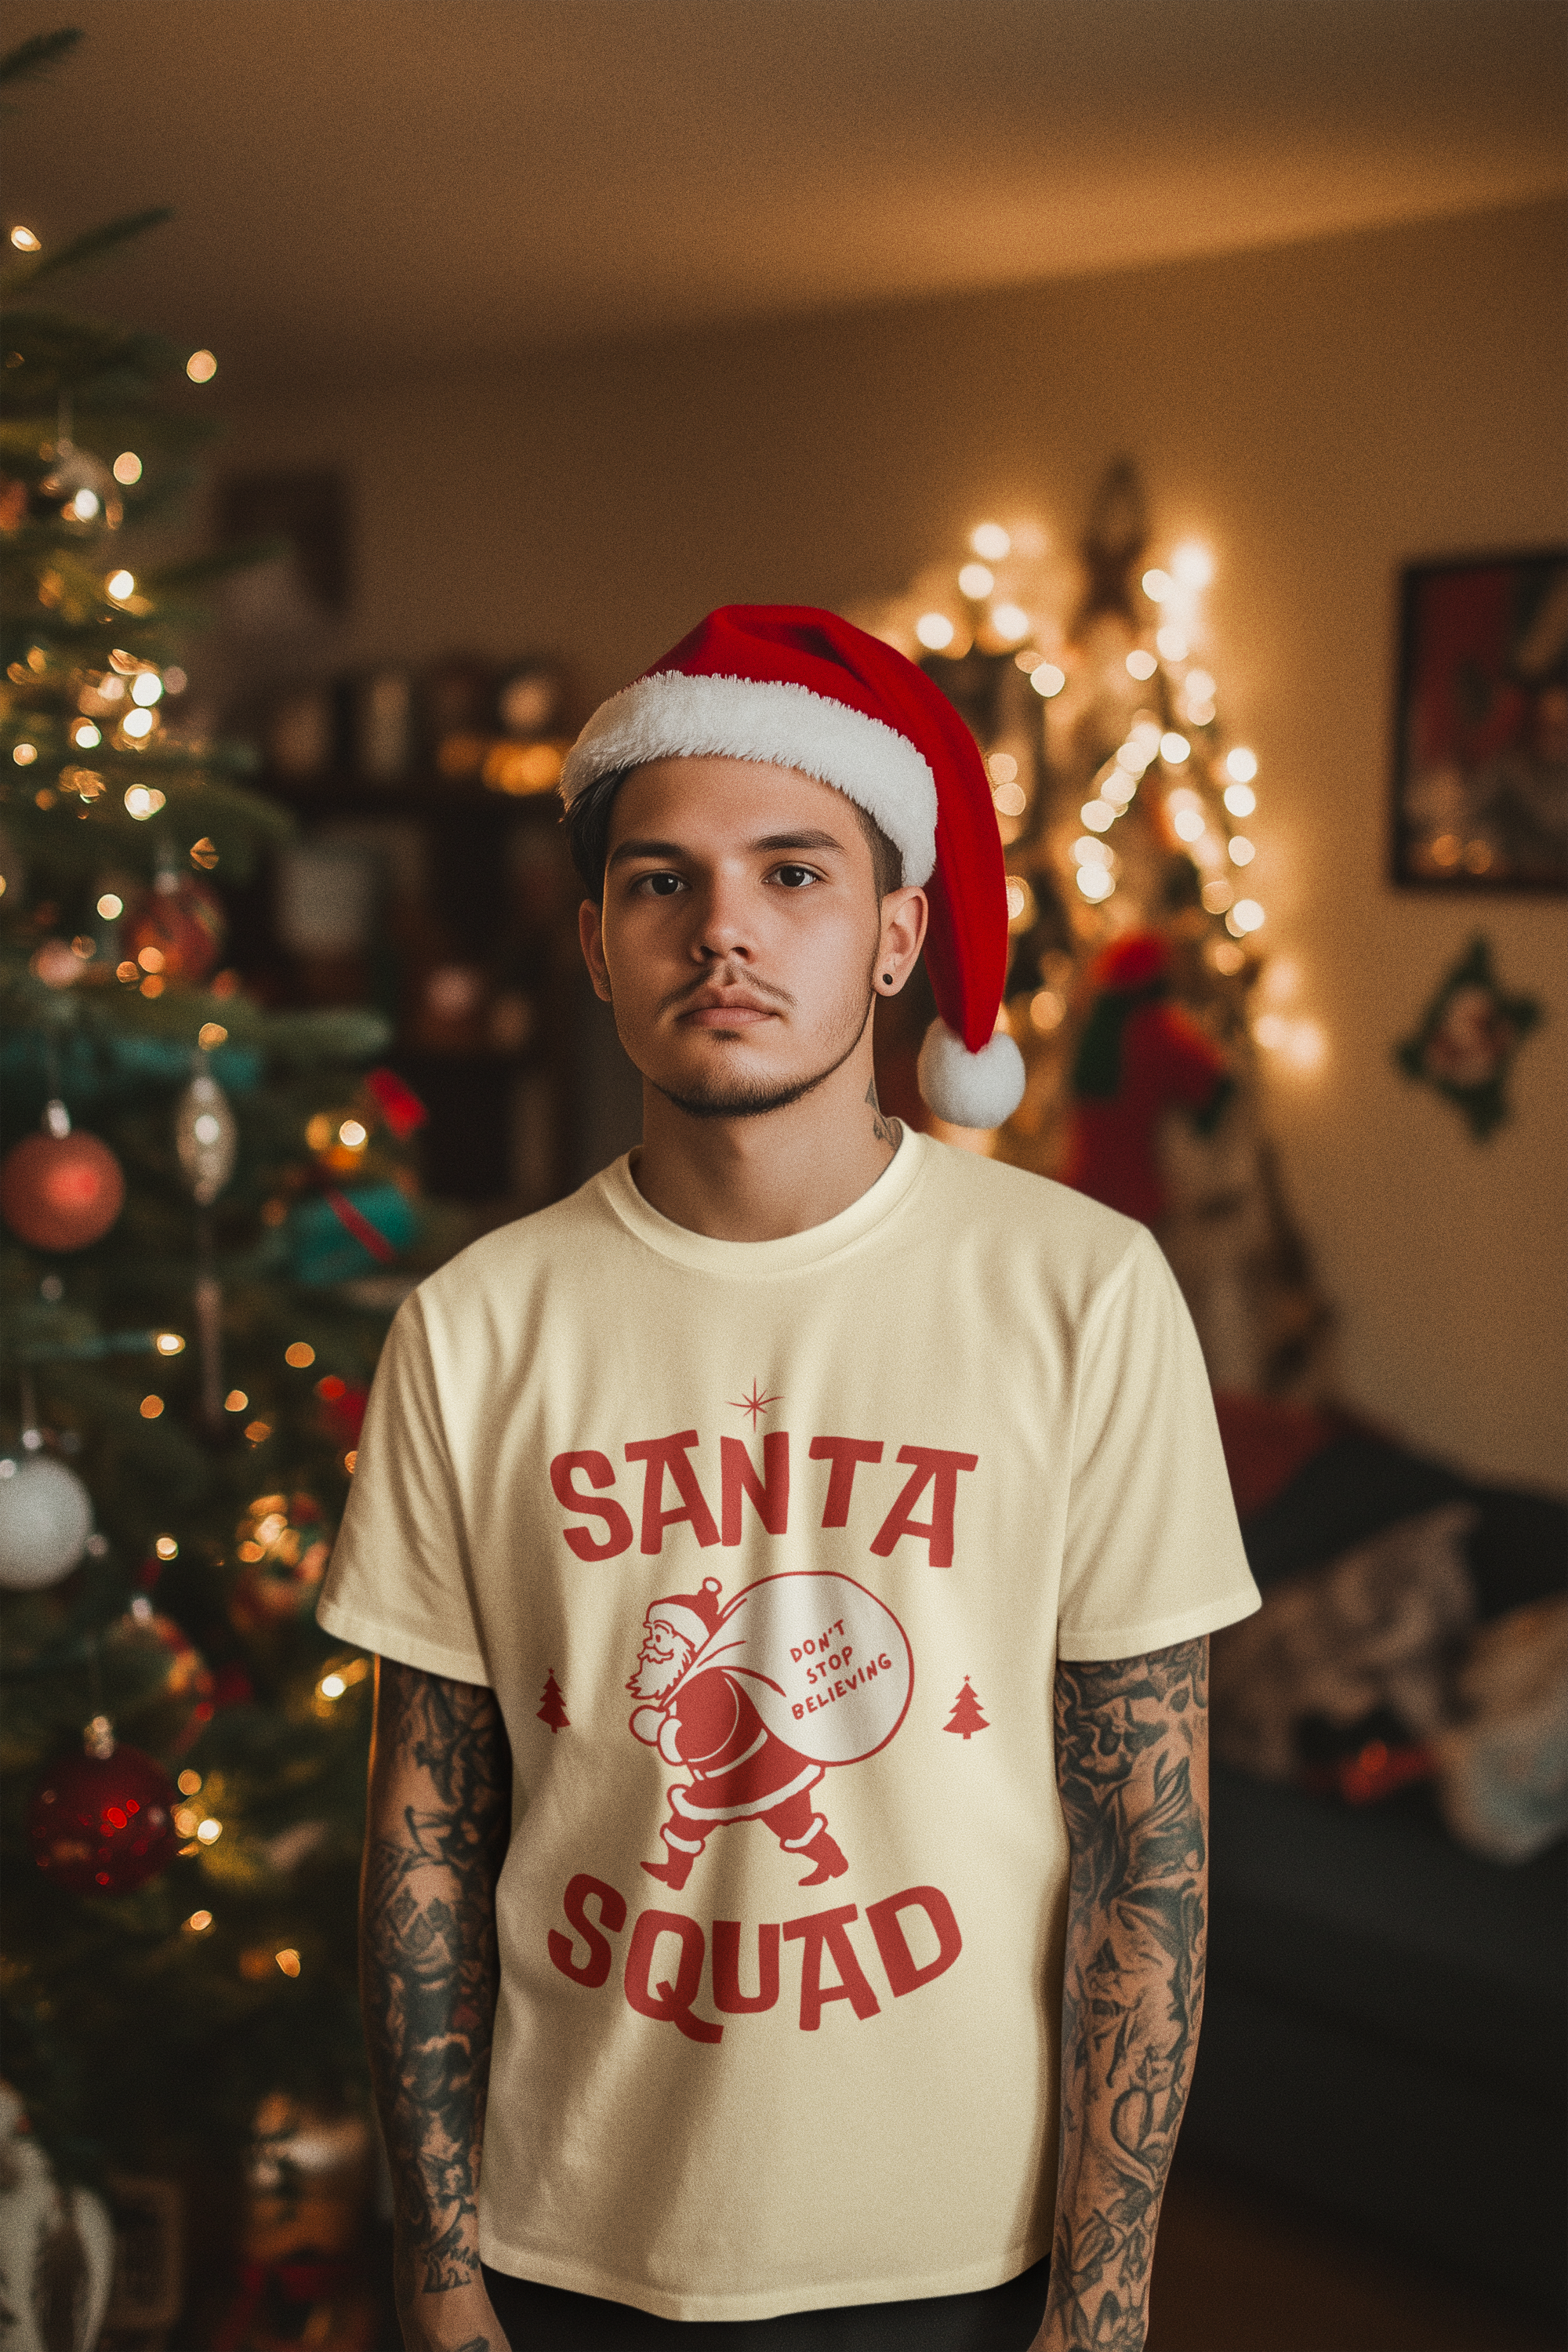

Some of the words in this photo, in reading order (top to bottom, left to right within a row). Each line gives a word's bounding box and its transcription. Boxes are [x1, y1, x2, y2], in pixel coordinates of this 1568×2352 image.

[550, 1429, 978, 1568] SANTA
[789, 1619, 844, 1663] DON'T
[806, 1646, 853, 1684] STOP
[791, 1653, 892, 1720] BELIEVING
[547, 1873, 963, 2044] SQUAD
